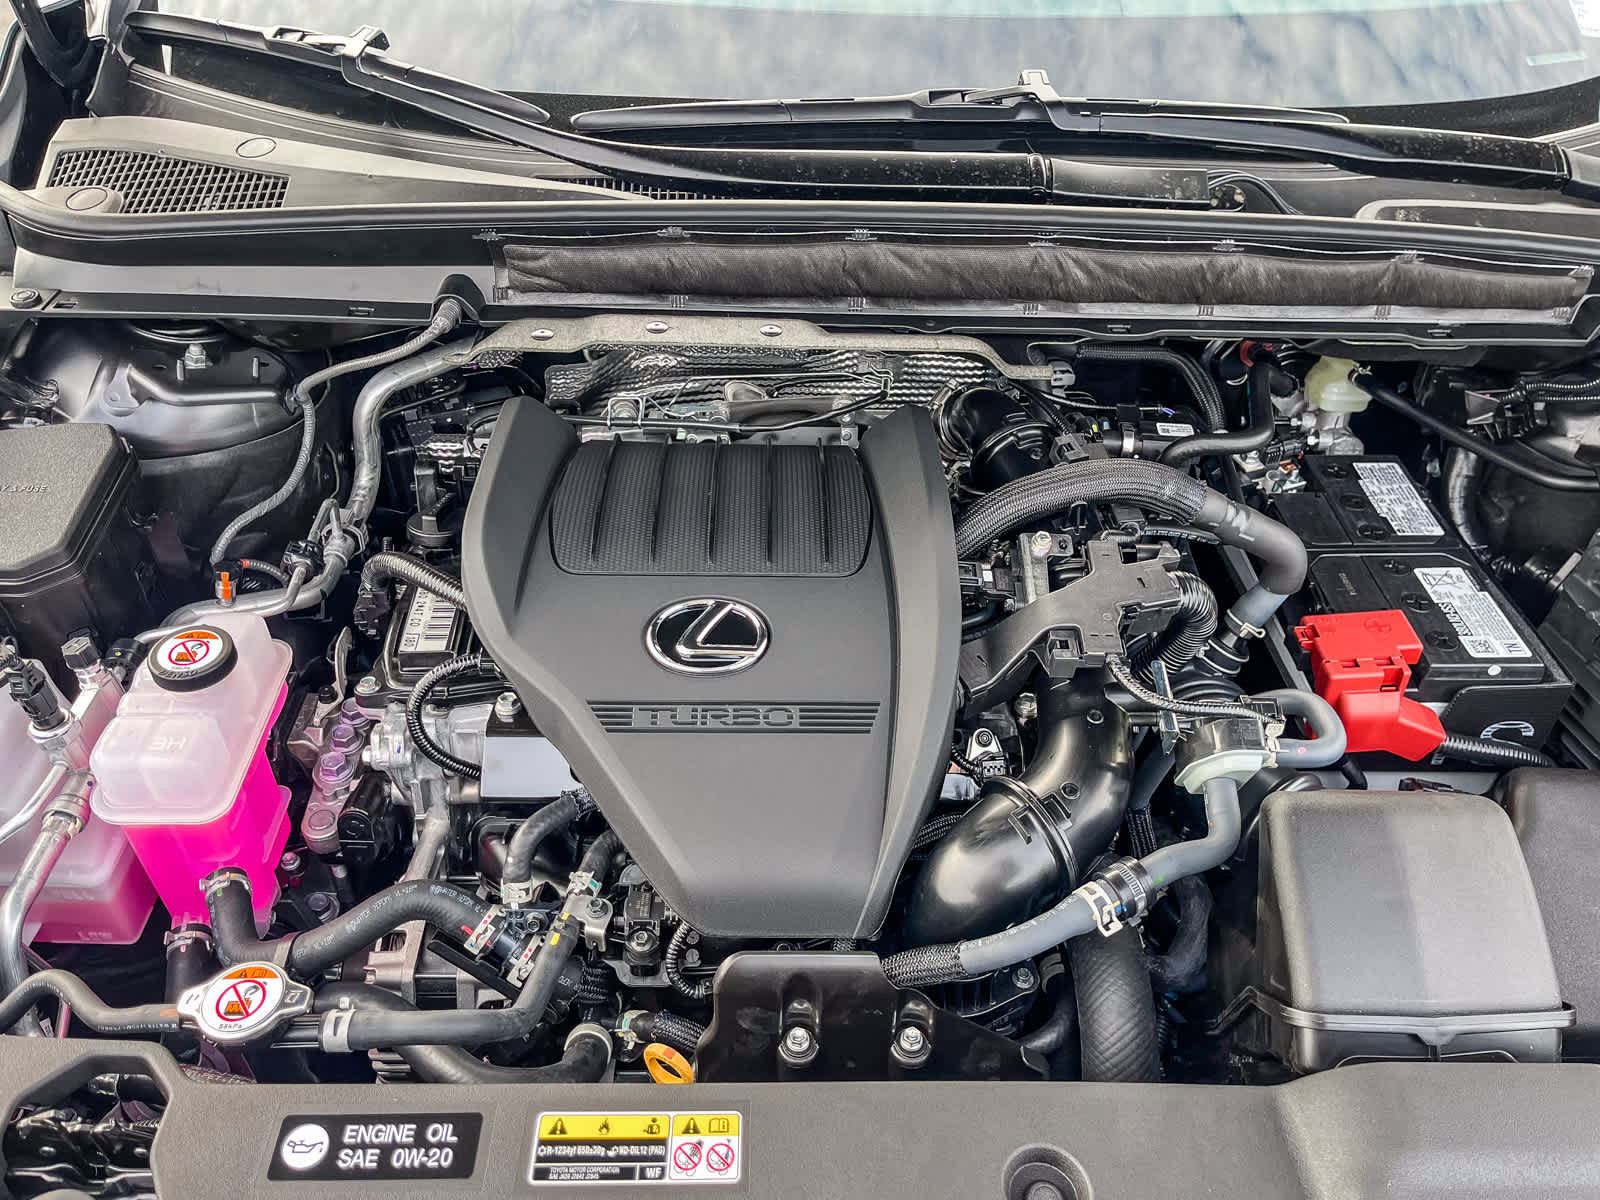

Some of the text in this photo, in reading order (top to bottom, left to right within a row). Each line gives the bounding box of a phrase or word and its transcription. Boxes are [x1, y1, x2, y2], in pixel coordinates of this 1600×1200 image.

[638, 707, 795, 727] TURBO
[343, 1122, 459, 1144] ENGINE OIL
[336, 1147, 454, 1170] SAE 0W-20
[645, 1167, 663, 1179] WF
